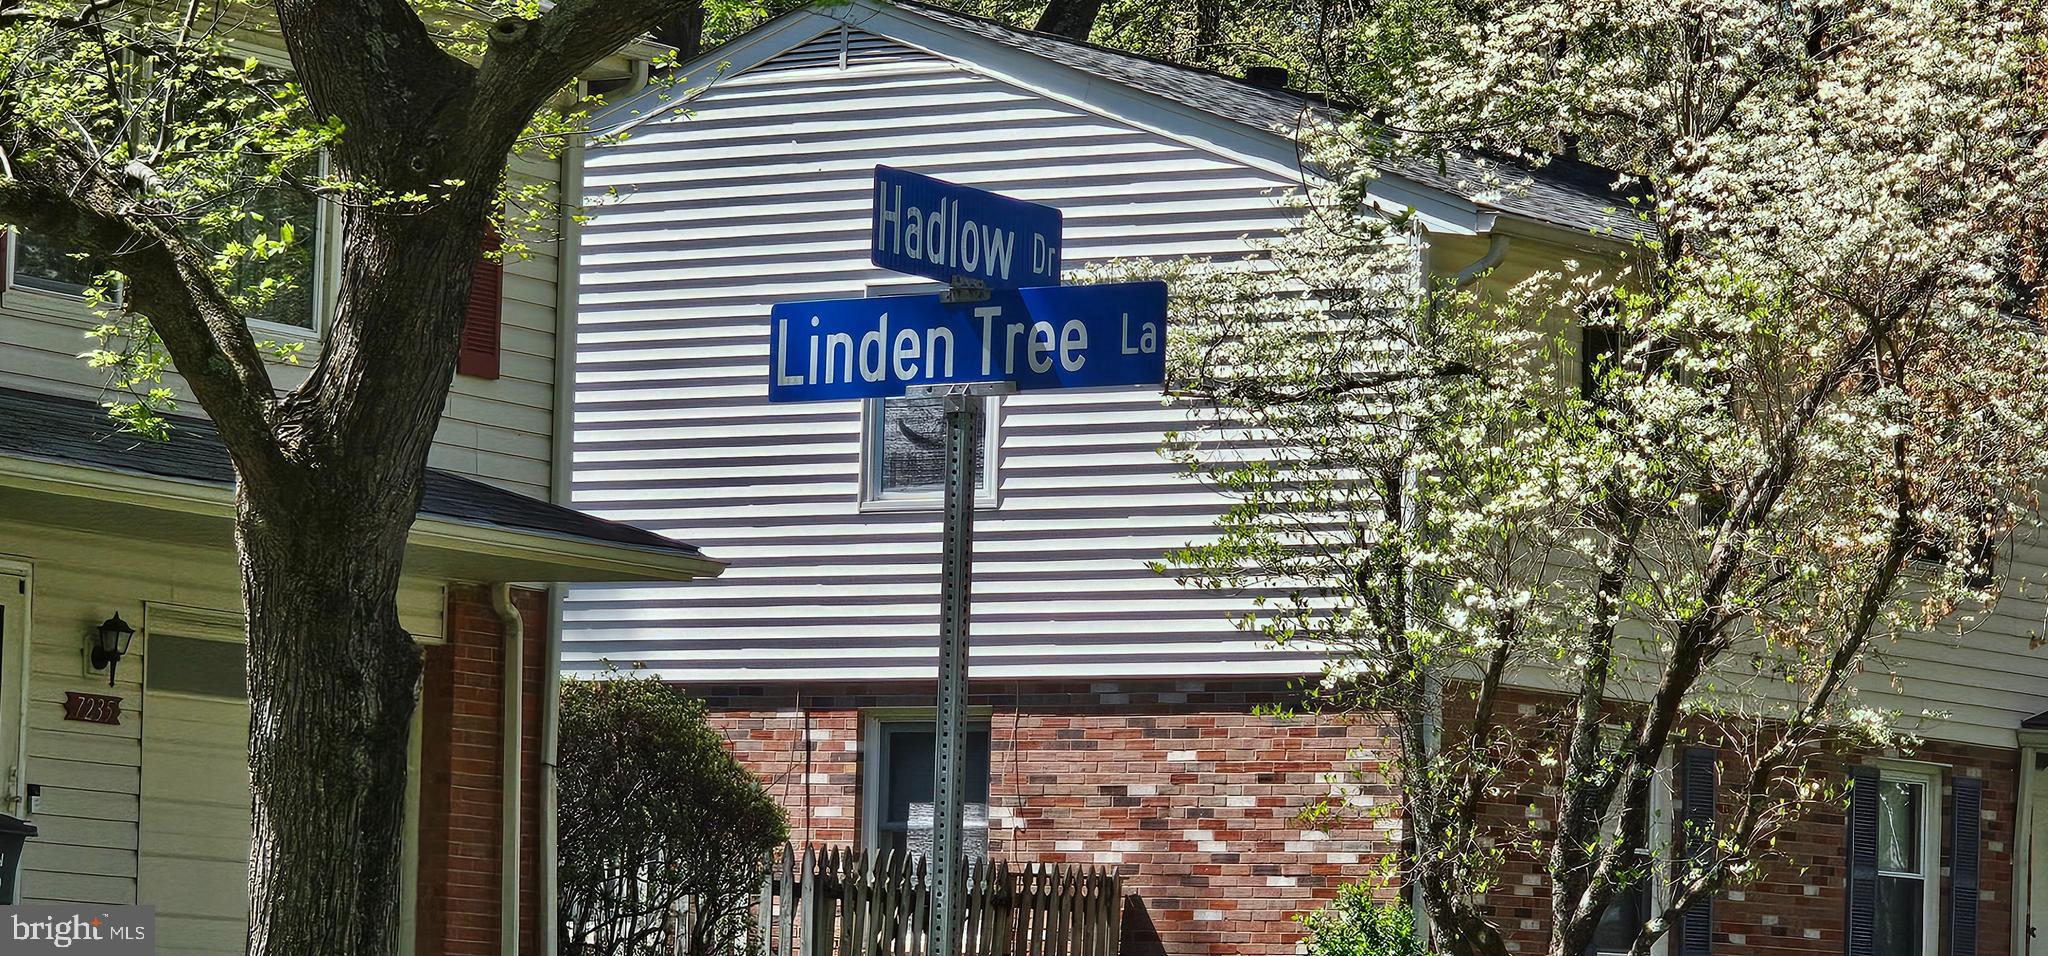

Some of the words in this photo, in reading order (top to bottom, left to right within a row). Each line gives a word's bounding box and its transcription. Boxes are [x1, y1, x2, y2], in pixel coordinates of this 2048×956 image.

[878, 180, 1016, 280] Hadlow
[1032, 232, 1056, 277] Dr
[777, 312, 955, 387] Linden
[974, 306, 1088, 376] Tree
[1121, 312, 1157, 355] La
[76, 696, 115, 722] 7235
